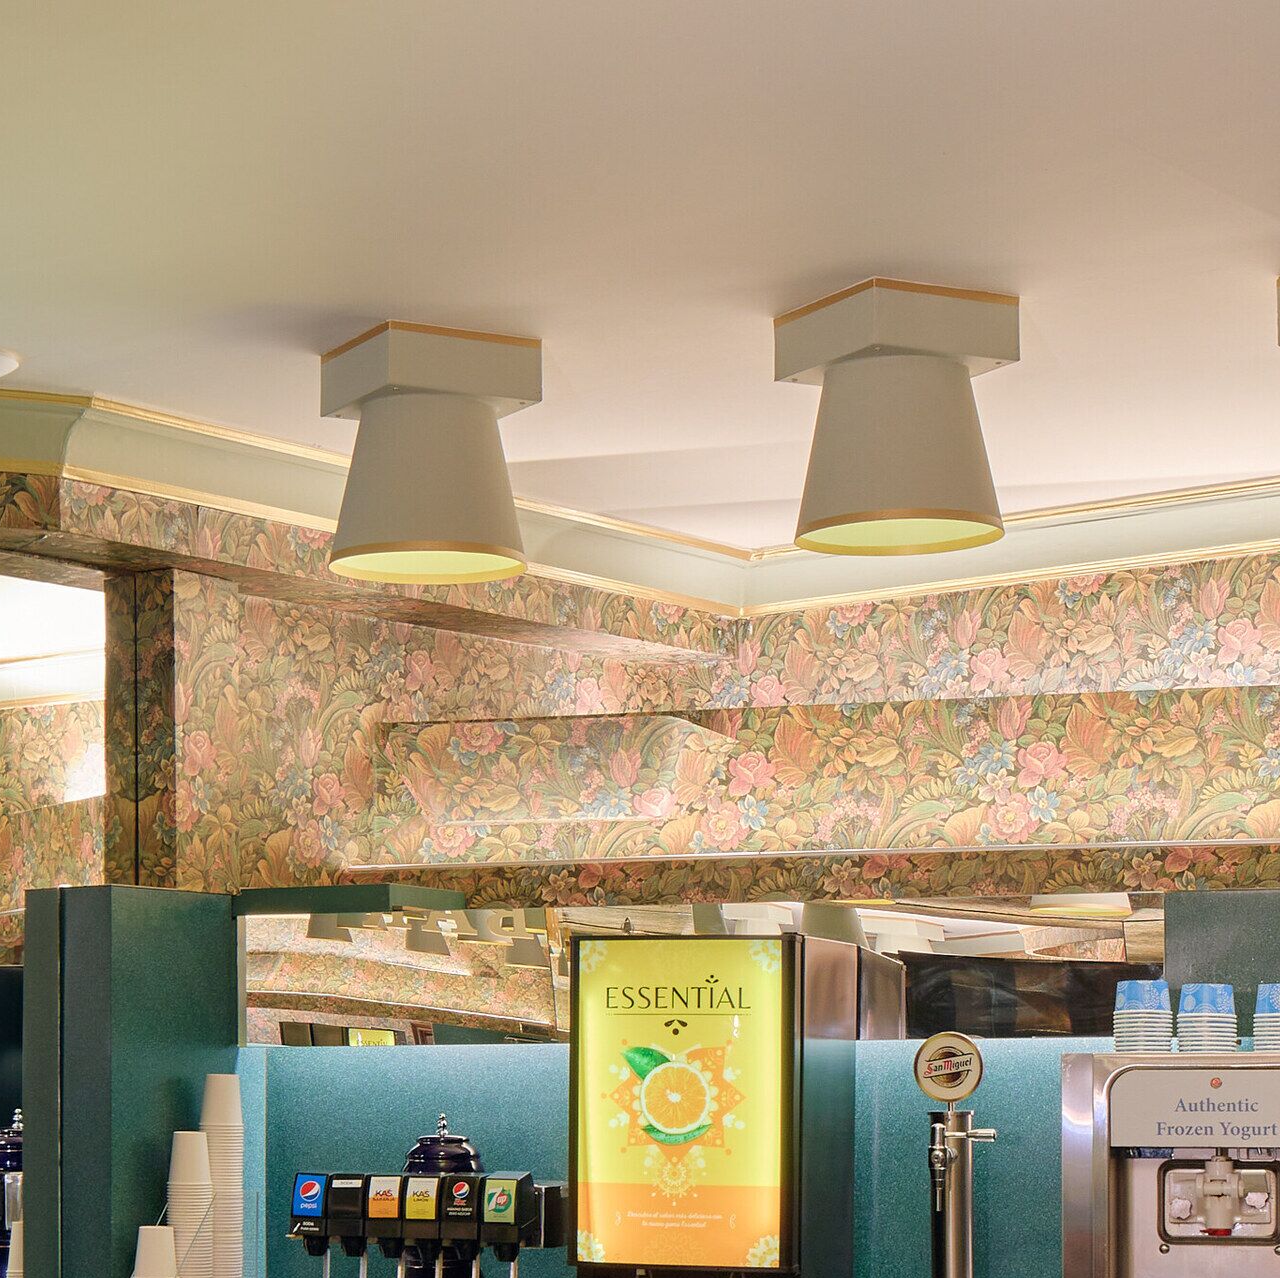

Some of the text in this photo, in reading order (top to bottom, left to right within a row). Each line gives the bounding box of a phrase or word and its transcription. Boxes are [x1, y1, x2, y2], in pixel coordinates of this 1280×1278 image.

[606, 986, 751, 1010] ESSENTIAL
[923, 1057, 972, 1076] San Miguel
[1175, 1098, 1259, 1112] Authentic
[1156, 1121, 1278, 1140] Frozen Yogurt
[376, 1189, 393, 1197] KAS
